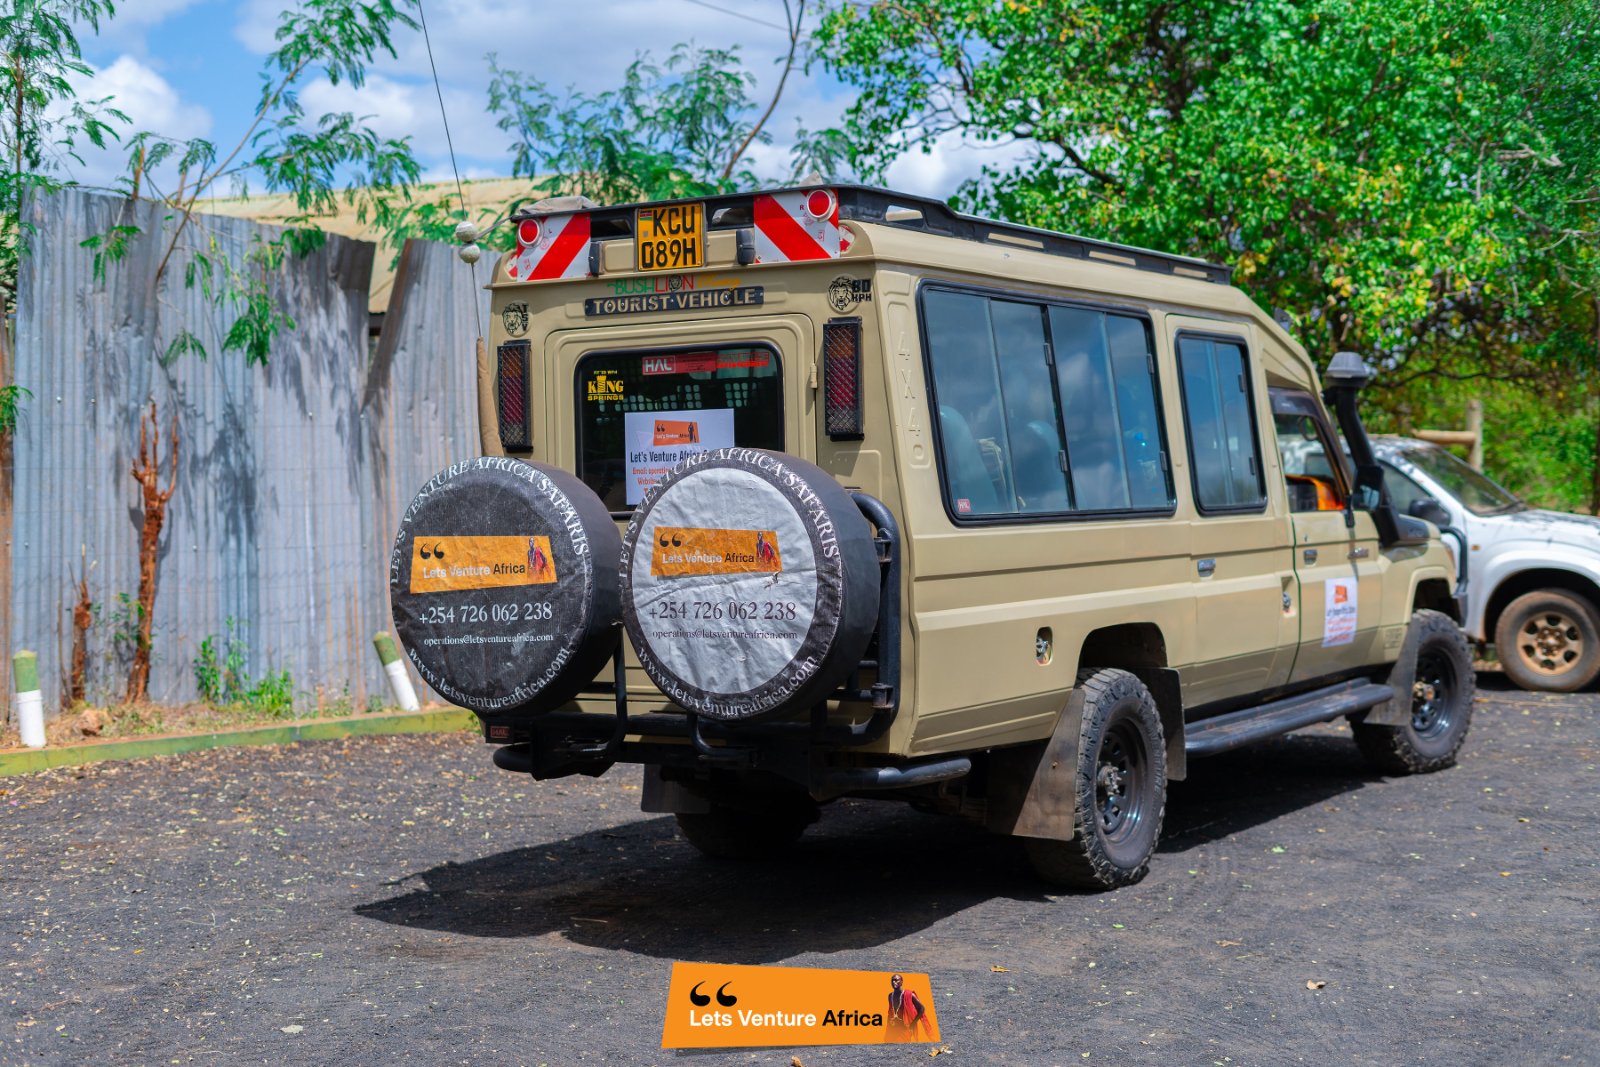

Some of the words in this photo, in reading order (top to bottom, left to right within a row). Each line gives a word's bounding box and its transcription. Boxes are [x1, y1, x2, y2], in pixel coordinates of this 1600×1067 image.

[653, 206, 695, 237] KCU
[641, 237, 697, 269] 089H
[593, 295, 671, 314] TOURIST
[676, 288, 756, 306] VEHICLE
[852, 293, 872, 302] KPH
[644, 359, 673, 373] HAL
[630, 452, 648, 464] Let's
[649, 450, 677, 462] Venture
[403, 458, 471, 524] VENTURE
[471, 456, 538, 484] AFRICA
[536, 477, 590, 556] SAFARIS
[635, 453, 710, 514] VENTURE
[711, 448, 784, 478] AFRICA
[783, 471, 841, 559] SAFARIS
[662, 553, 683, 564] Lets
[685, 550, 722, 563] Venture
[724, 553, 755, 563] Africa
[423, 567, 447, 579] Lets
[449, 565, 491, 577] Venture
[493, 563, 526, 575] Africa
[419, 606, 455, 625] +254
[460, 604, 488, 623] 726
[491, 603, 519, 622] 062
[523, 602, 553, 621] 238
[649, 601, 688, 619] +254
[693, 601, 723, 619] 726
[728, 601, 758, 620] 062
[763, 601, 797, 621] 238
[409, 647, 571, 710] www.letsventureafrica.com
[638, 648, 819, 718] www.letsventureafrica.com
